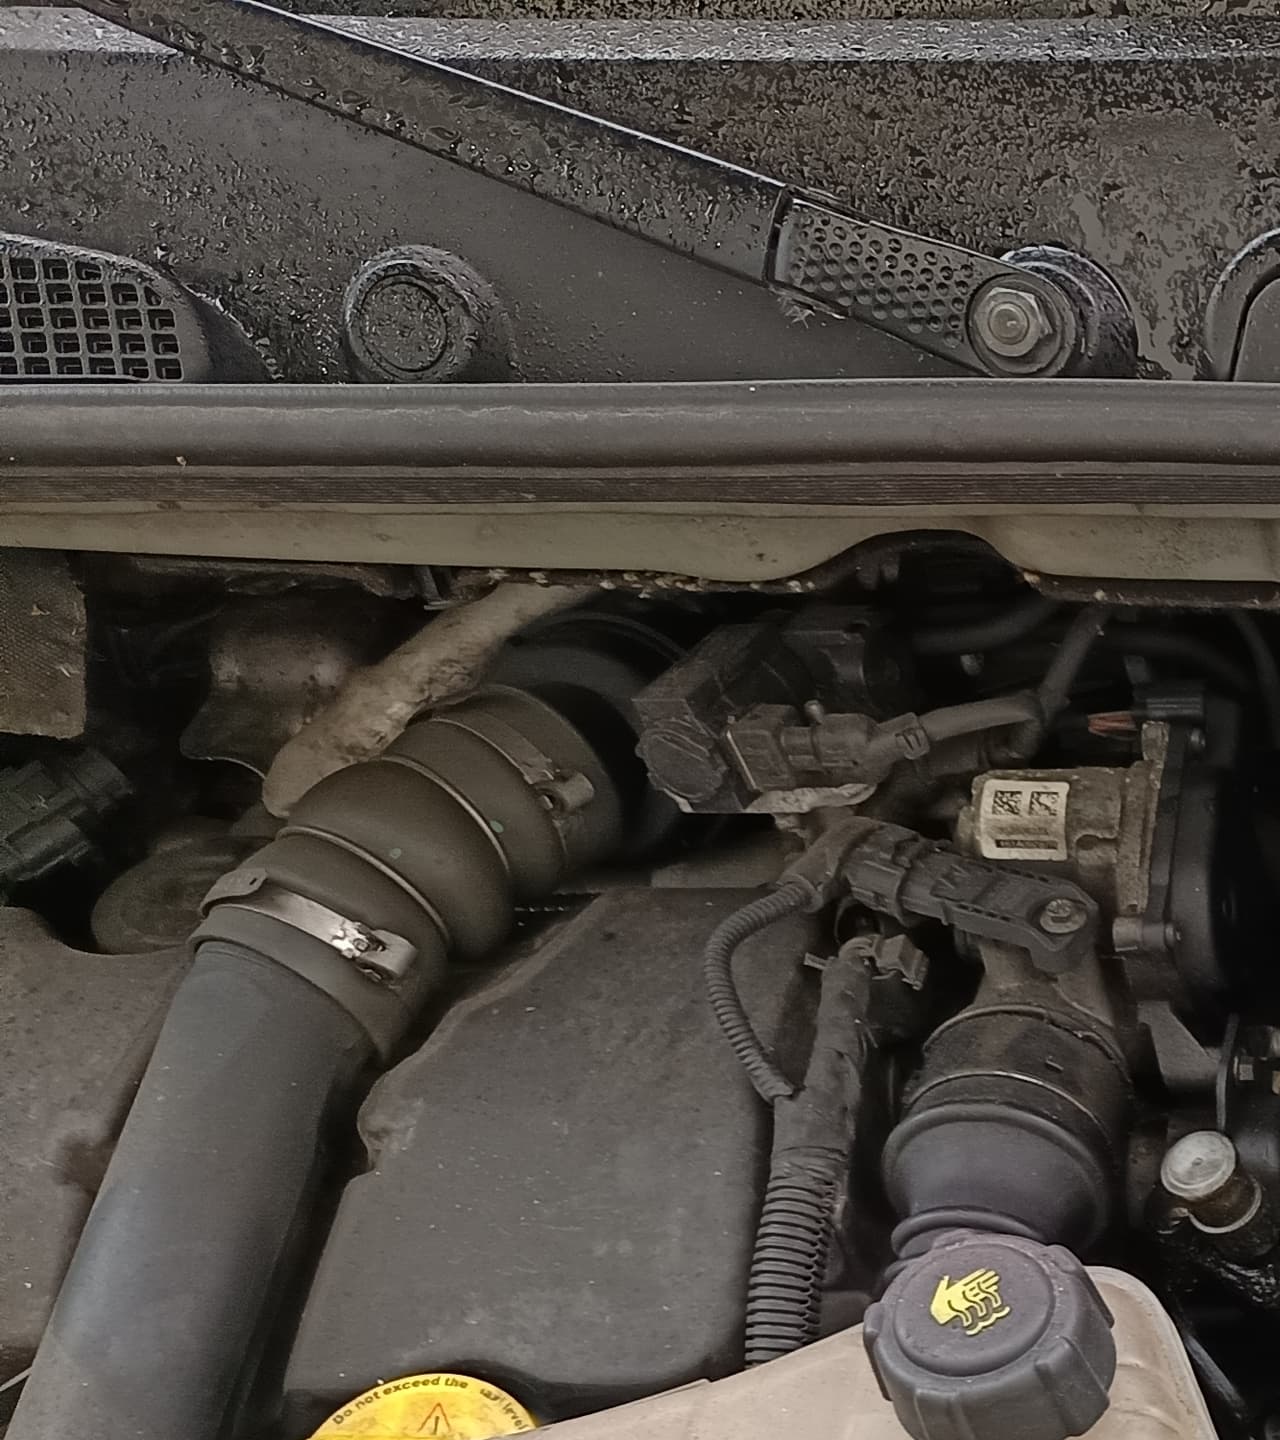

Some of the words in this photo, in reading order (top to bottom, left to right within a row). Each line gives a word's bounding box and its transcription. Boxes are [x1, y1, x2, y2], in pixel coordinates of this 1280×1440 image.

[332, 1408, 354, 1425] Do
[354, 1391, 382, 1410] not
[382, 1376, 441, 1396] exceed
[444, 1376, 469, 1389] the
